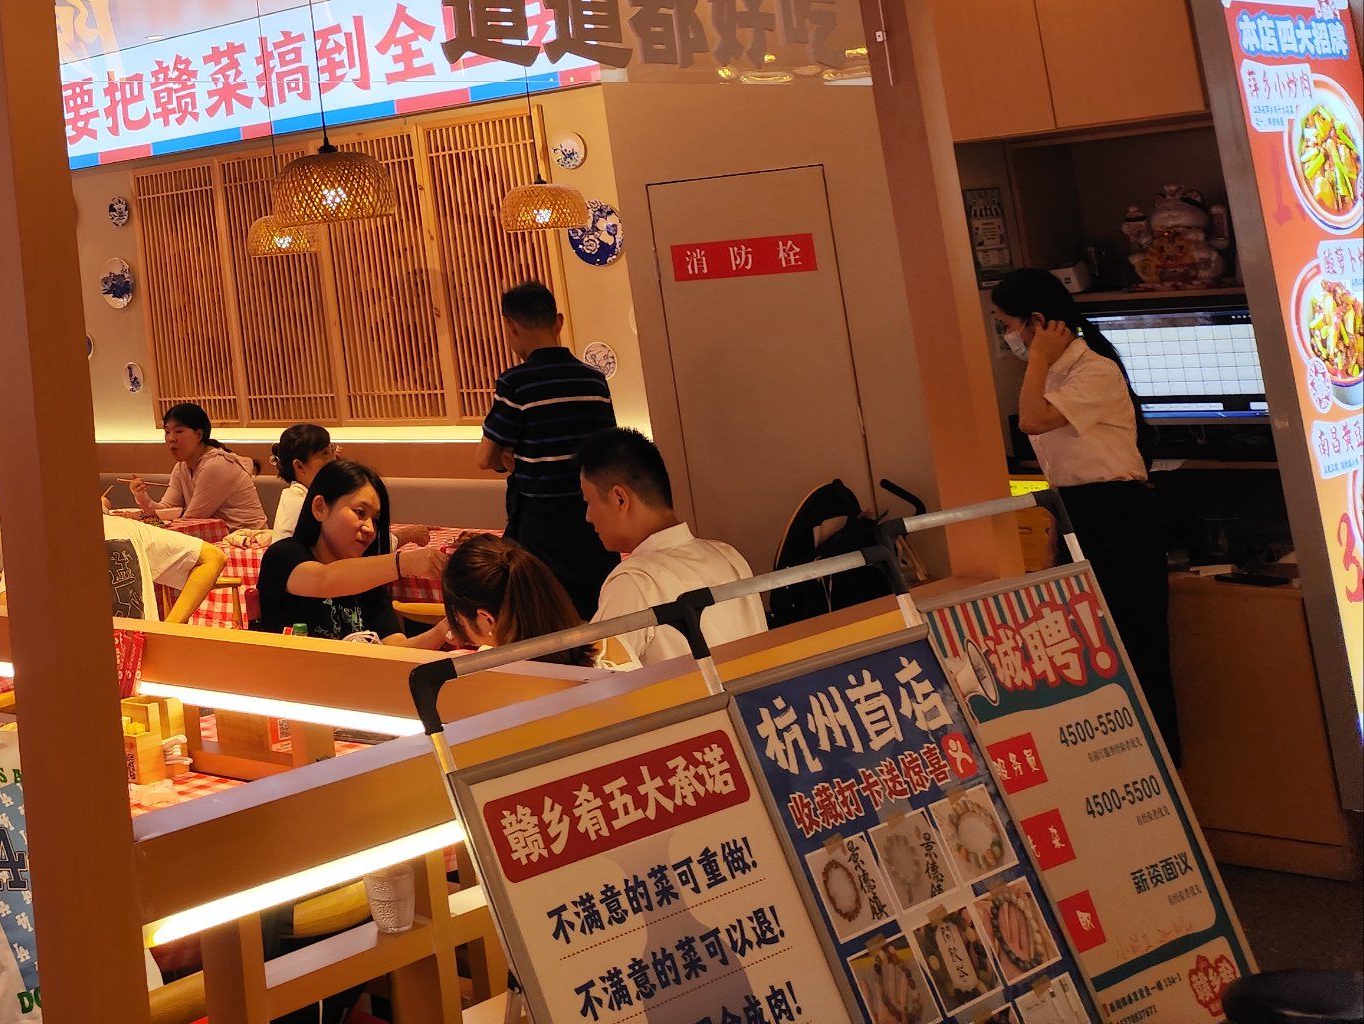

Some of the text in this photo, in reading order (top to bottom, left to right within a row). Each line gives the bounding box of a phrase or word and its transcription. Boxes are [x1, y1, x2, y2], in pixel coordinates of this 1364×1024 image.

[1238, 14, 1349, 57] 本店四大招牌
[686, 241, 802, 275] 消防栓
[756, 656, 953, 775] 杭州首店
[1059, 706, 1134, 748] 4500-5500
[499, 743, 737, 866] 赣乡肴五大承诺
[787, 741, 952, 839] 收藏打卡送惊喜
[1085, 775, 1161, 819] 4500-5500
[547, 836, 759, 945] 不满意的菜可重做！
[1130, 851, 1193, 894] 薪资面议
[574, 905, 787, 1023] 不满意的菜可以退！
